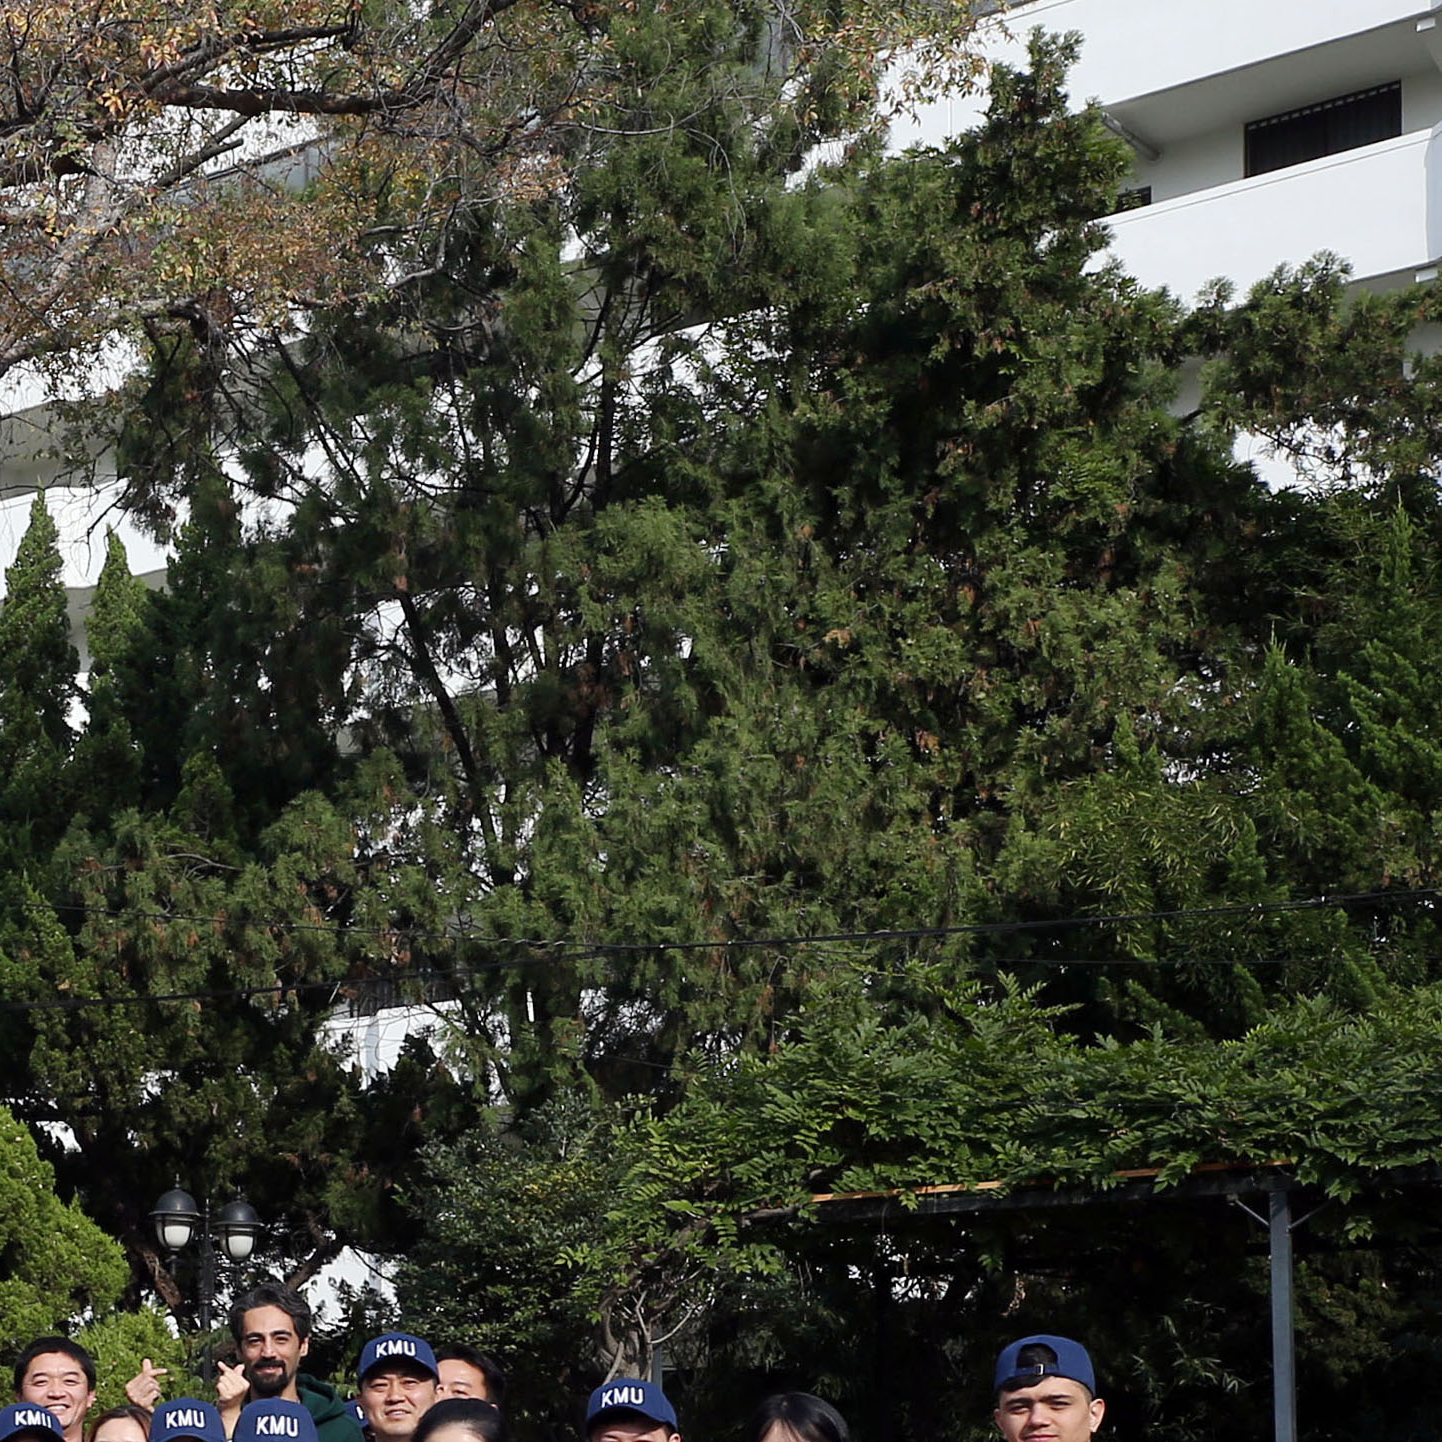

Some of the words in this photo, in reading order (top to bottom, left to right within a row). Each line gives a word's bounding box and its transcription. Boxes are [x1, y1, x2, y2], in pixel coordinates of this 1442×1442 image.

[376, 1339, 415, 1358] KMU
[602, 1386, 643, 1408] KMU
[14, 1410, 51, 1429] KMU
[166, 1409, 205, 1429] KMU
[256, 1415, 299, 1437] KMU
